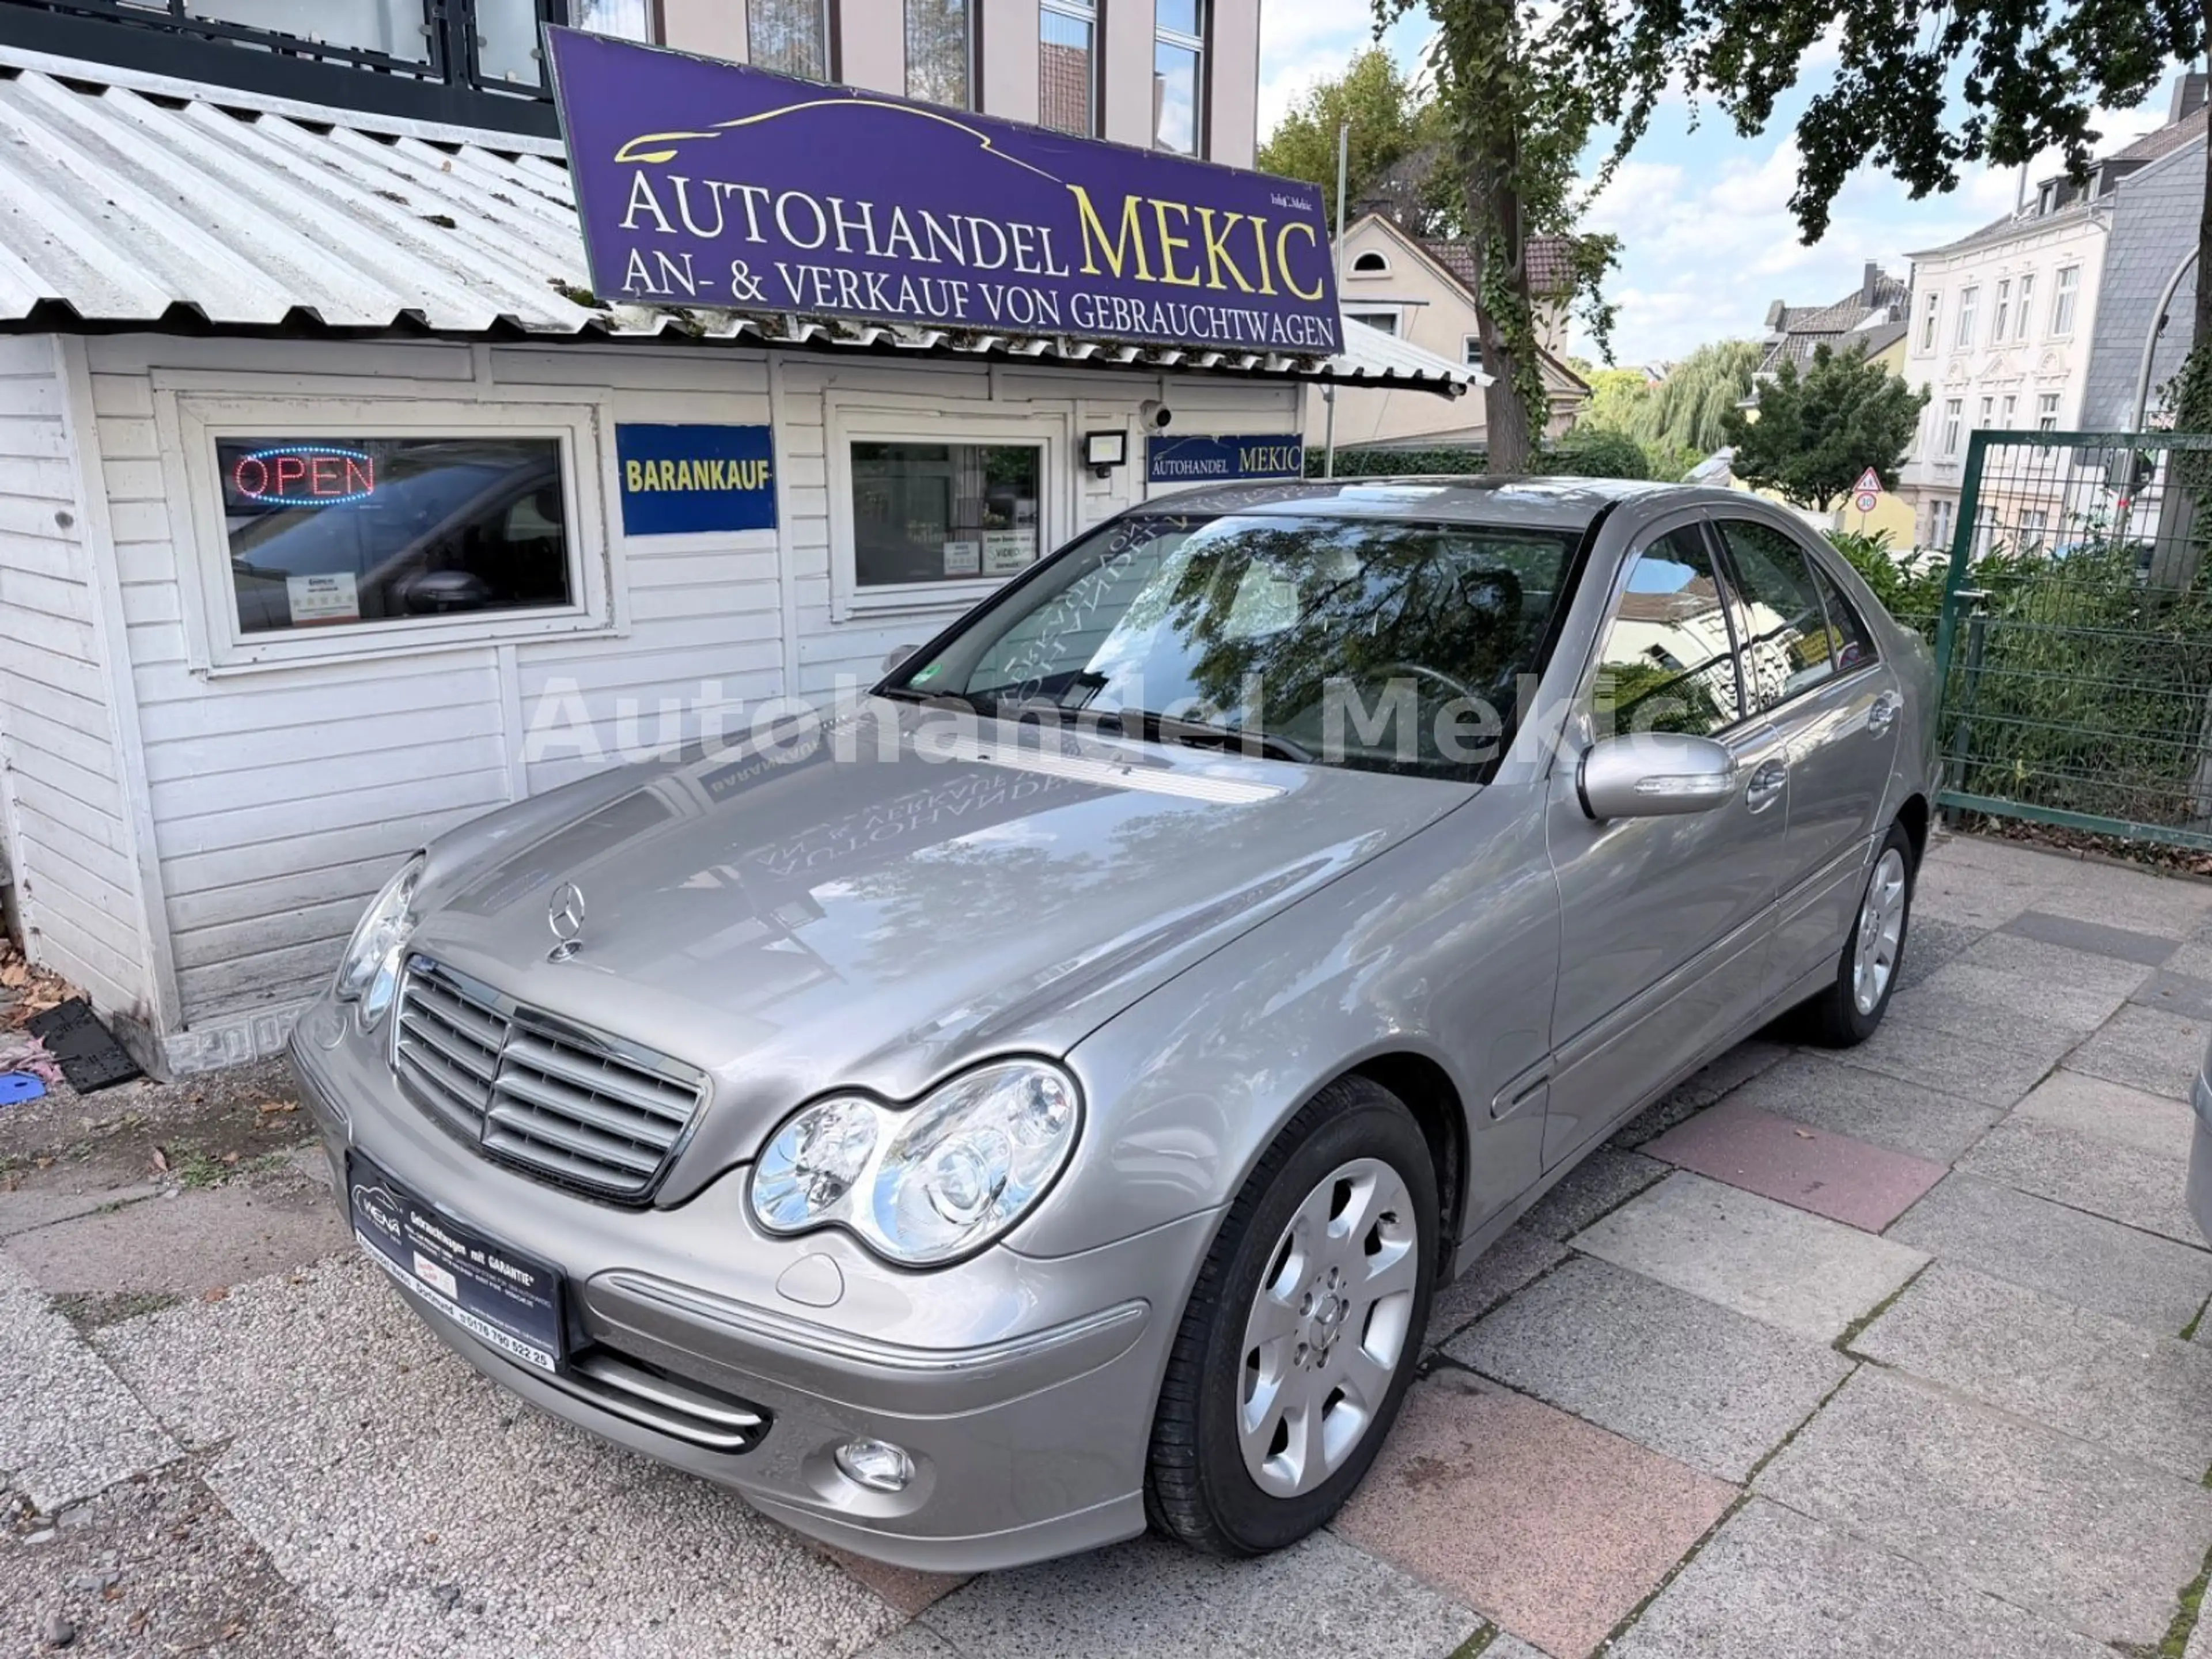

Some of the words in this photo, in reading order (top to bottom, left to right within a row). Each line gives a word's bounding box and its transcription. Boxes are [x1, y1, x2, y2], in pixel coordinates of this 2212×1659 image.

[618, 170, 1069, 277] AUTOHANDEL
[1066, 183, 1324, 301] MEKIC
[621, 248, 715, 296] AN-
[730, 259, 768, 301] &
[773, 262, 969, 319] VERKAUF
[978, 282, 1062, 326] VON
[1070, 292, 1335, 347] GEBRAUCHTWAGEN
[235, 456, 374, 498] OPEN
[625, 459, 769, 493] BARANKAUF
[1152, 459, 1229, 476] AUTOHANDEL
[1238, 445, 1301, 473] MEKIC
[470, 1249, 486, 1266] mit
